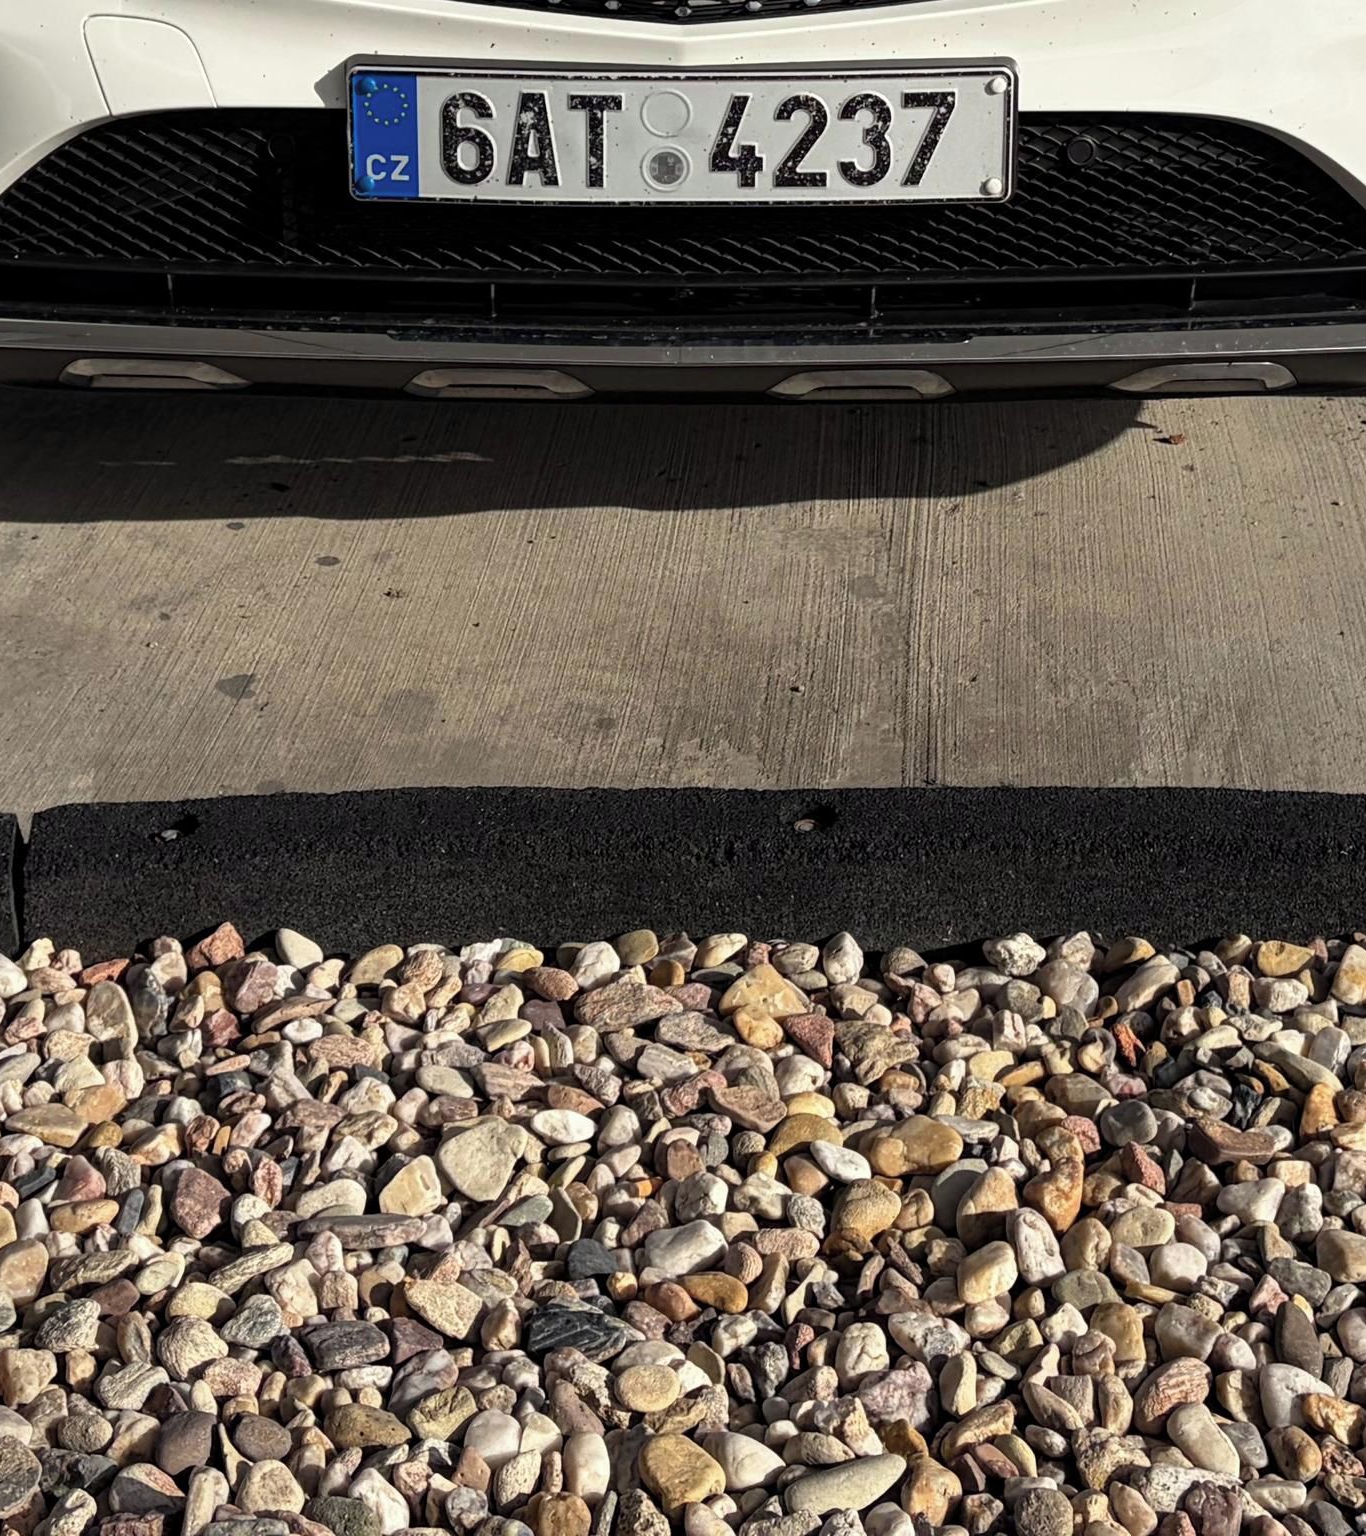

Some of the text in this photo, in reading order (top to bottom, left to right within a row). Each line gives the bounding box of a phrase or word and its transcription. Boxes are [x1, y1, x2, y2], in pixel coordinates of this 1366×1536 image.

[366, 89, 958, 189] CZ 6AT 4237
